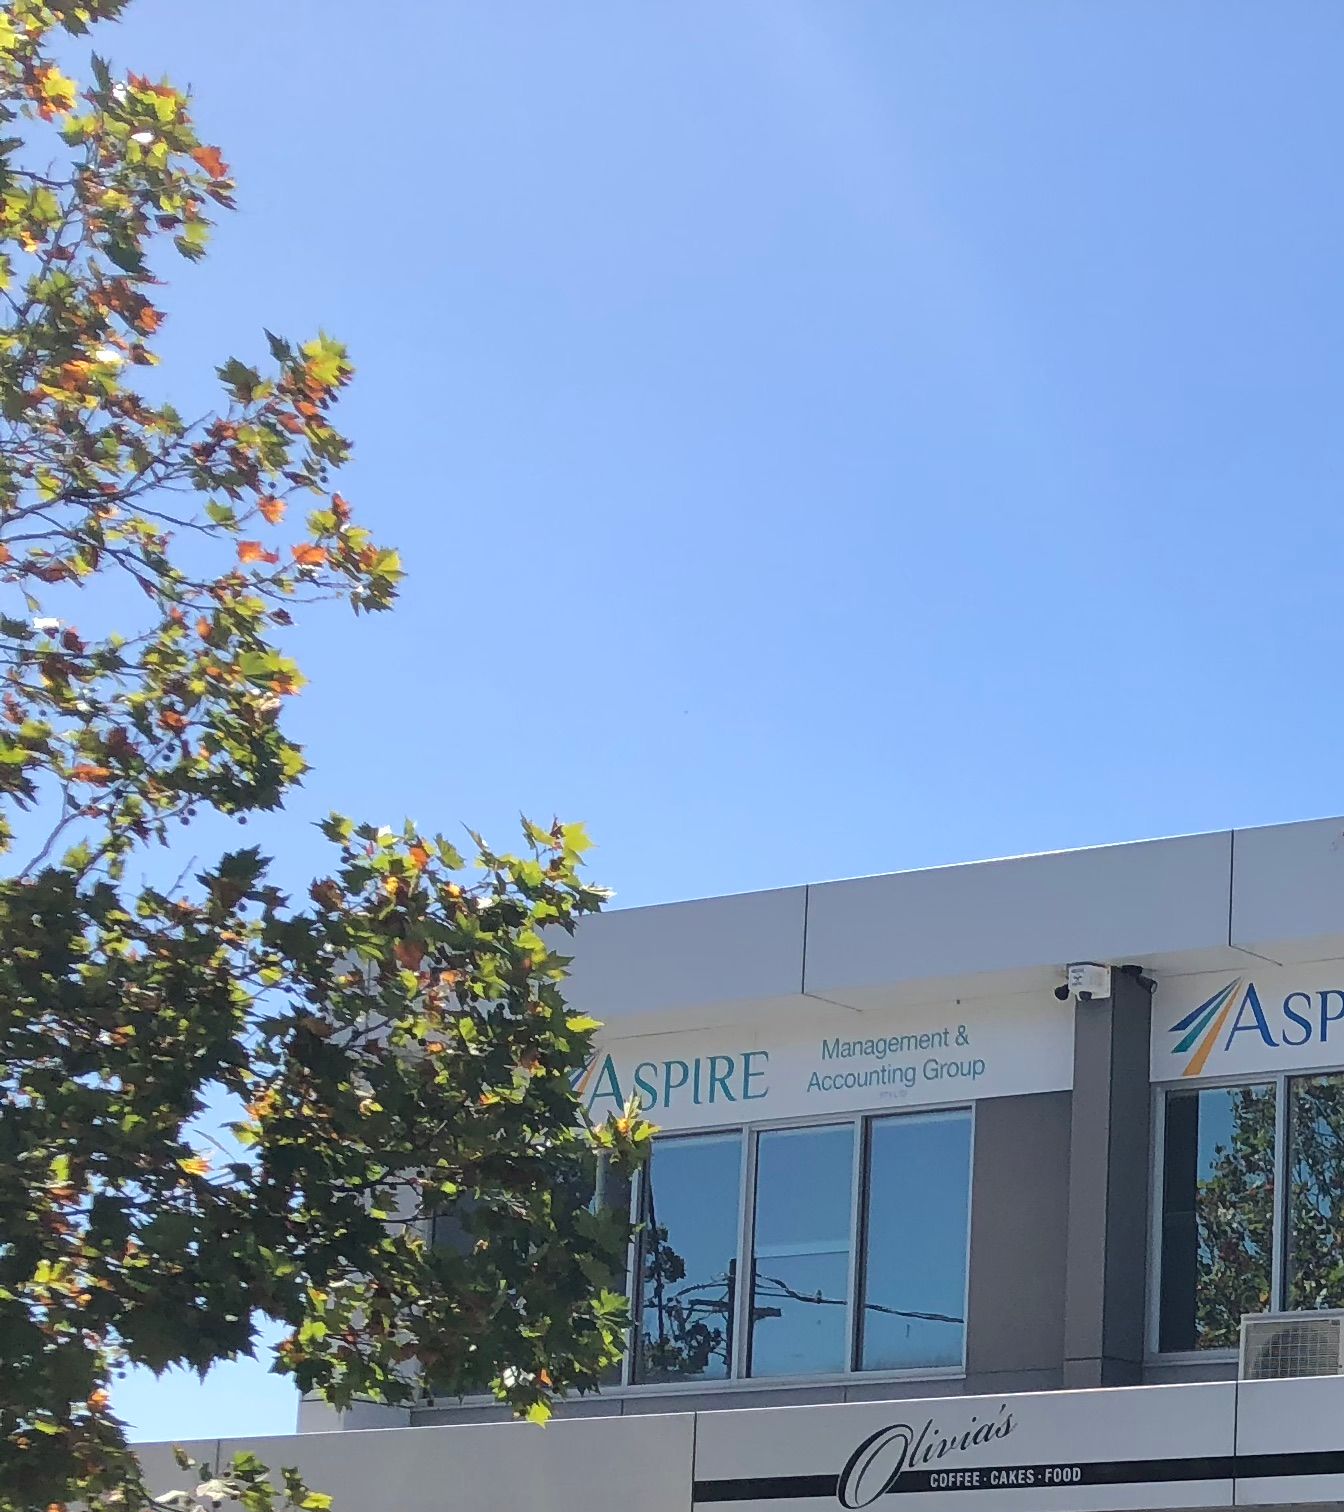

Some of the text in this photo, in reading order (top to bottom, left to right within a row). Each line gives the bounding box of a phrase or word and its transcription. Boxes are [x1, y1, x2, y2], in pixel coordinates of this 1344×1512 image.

[821, 1024, 969, 1060] Management &
[587, 1050, 770, 1113] ASPIRE
[806, 1056, 986, 1093] Accounting Group
[837, 1403, 1018, 1510] Olivia's
[930, 1467, 1082, 1488] COFFEE CAKES FOOD
